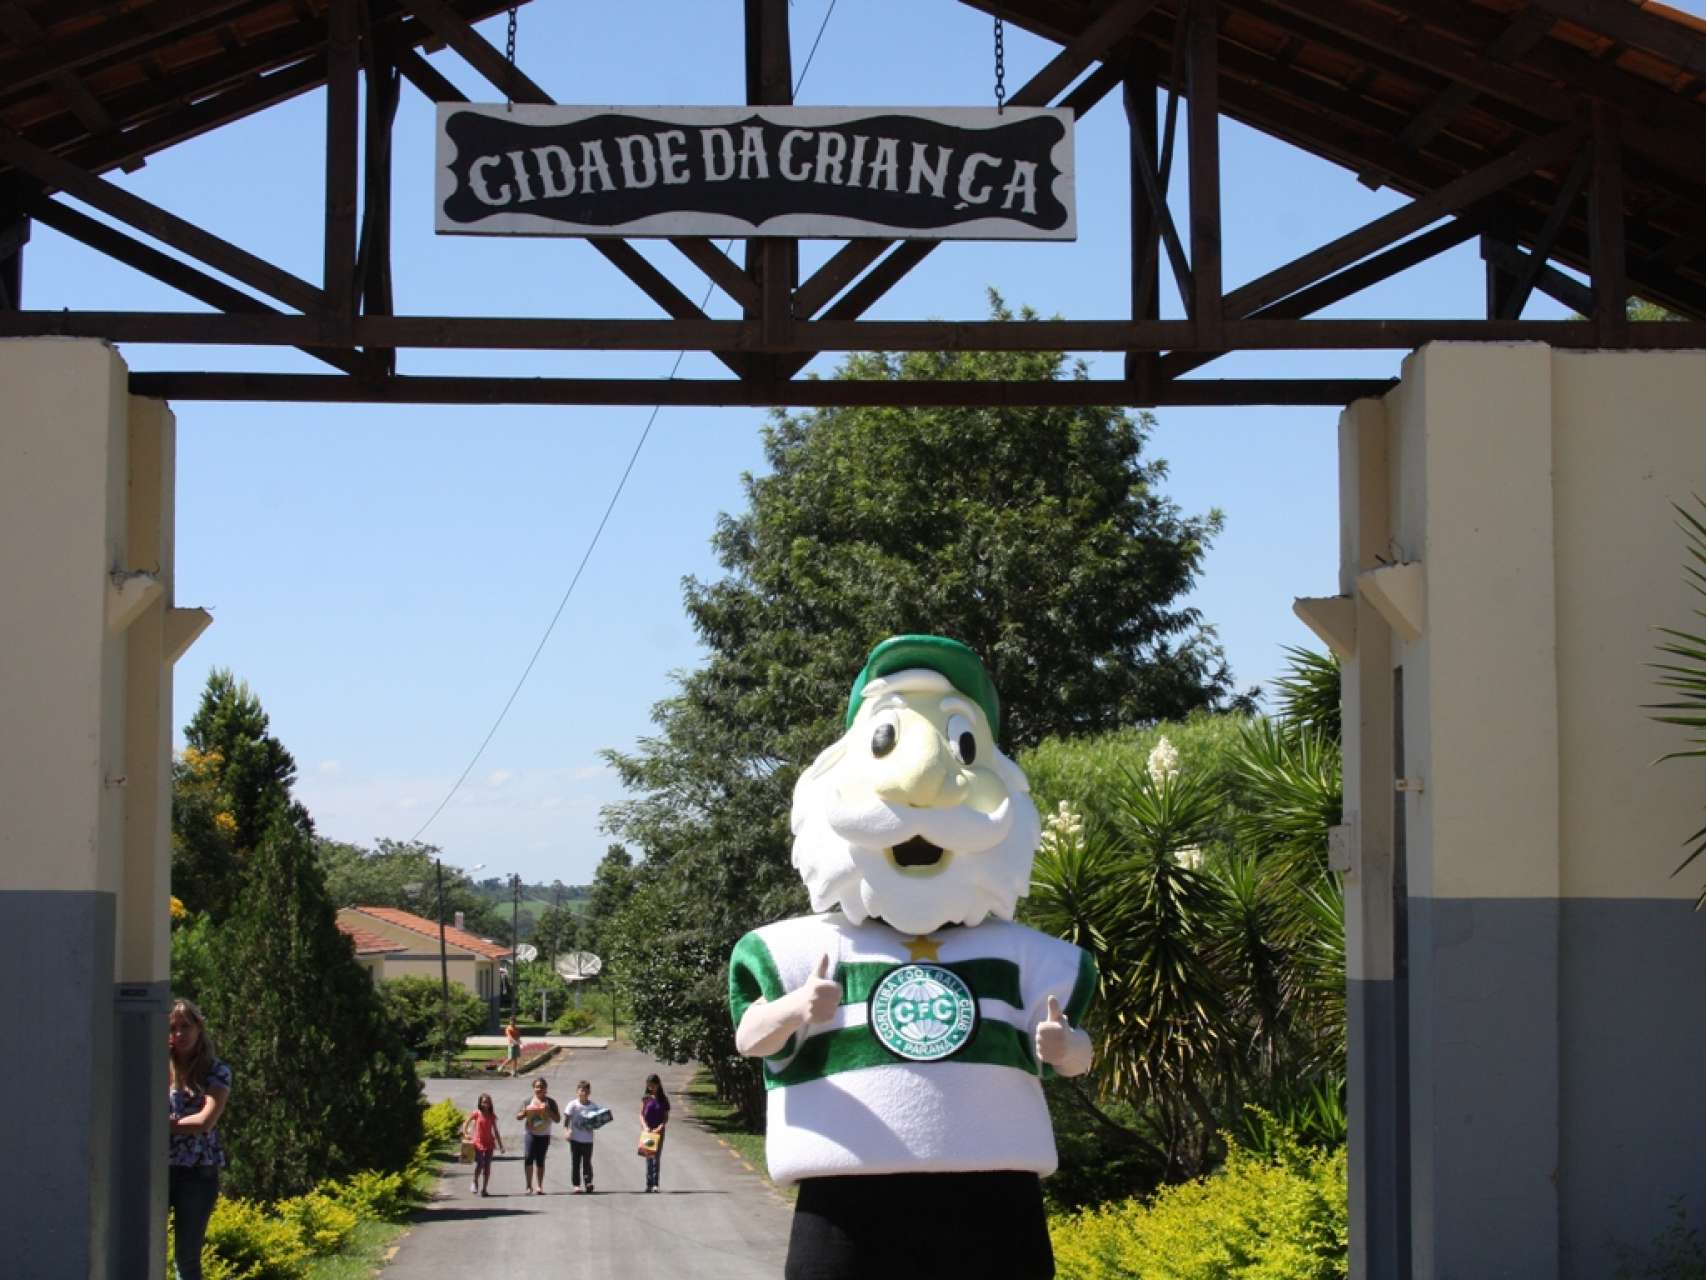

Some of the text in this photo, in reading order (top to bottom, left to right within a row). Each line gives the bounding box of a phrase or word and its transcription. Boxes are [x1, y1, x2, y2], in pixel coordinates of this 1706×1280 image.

[468, 126, 1039, 214] CIDADE DA CRIANÇA
[894, 998, 952, 1023] CFC
